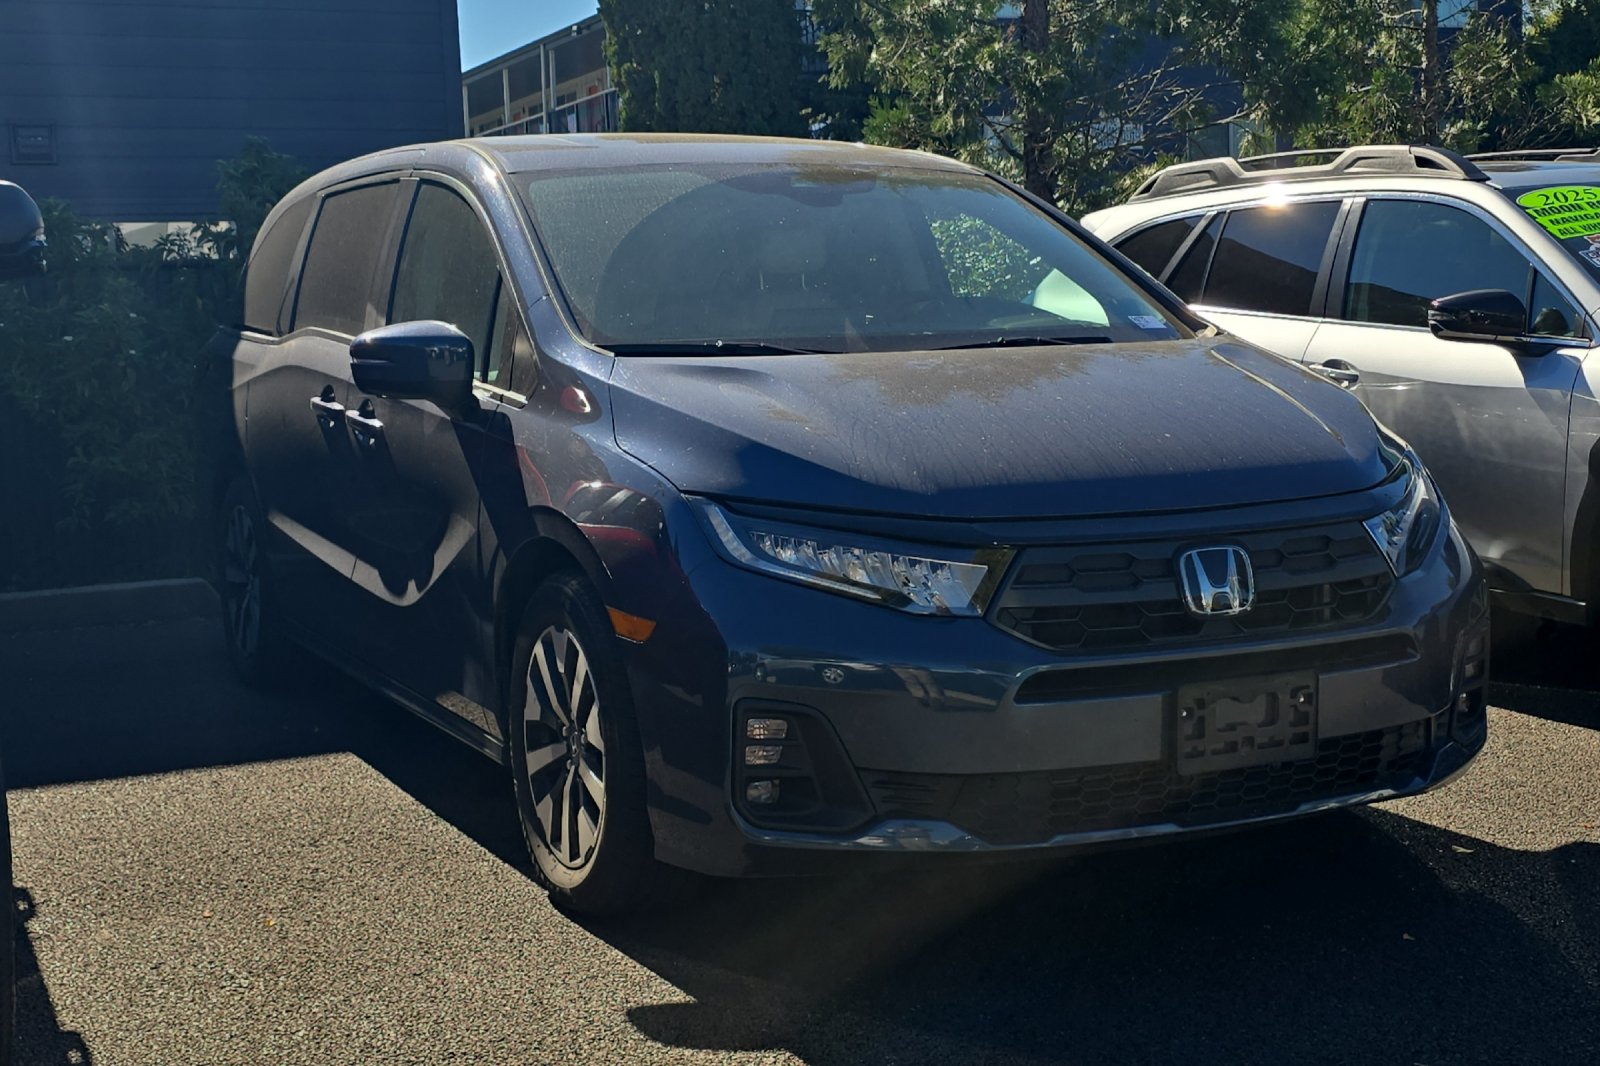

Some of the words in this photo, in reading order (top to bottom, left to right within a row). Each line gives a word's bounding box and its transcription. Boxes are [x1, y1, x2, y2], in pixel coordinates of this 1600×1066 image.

[1537, 188, 1598, 206] 2025
[1533, 203, 1585, 217] MOON
[1585, 200, 1600, 210] R
[1557, 226, 1584, 236] ALL
